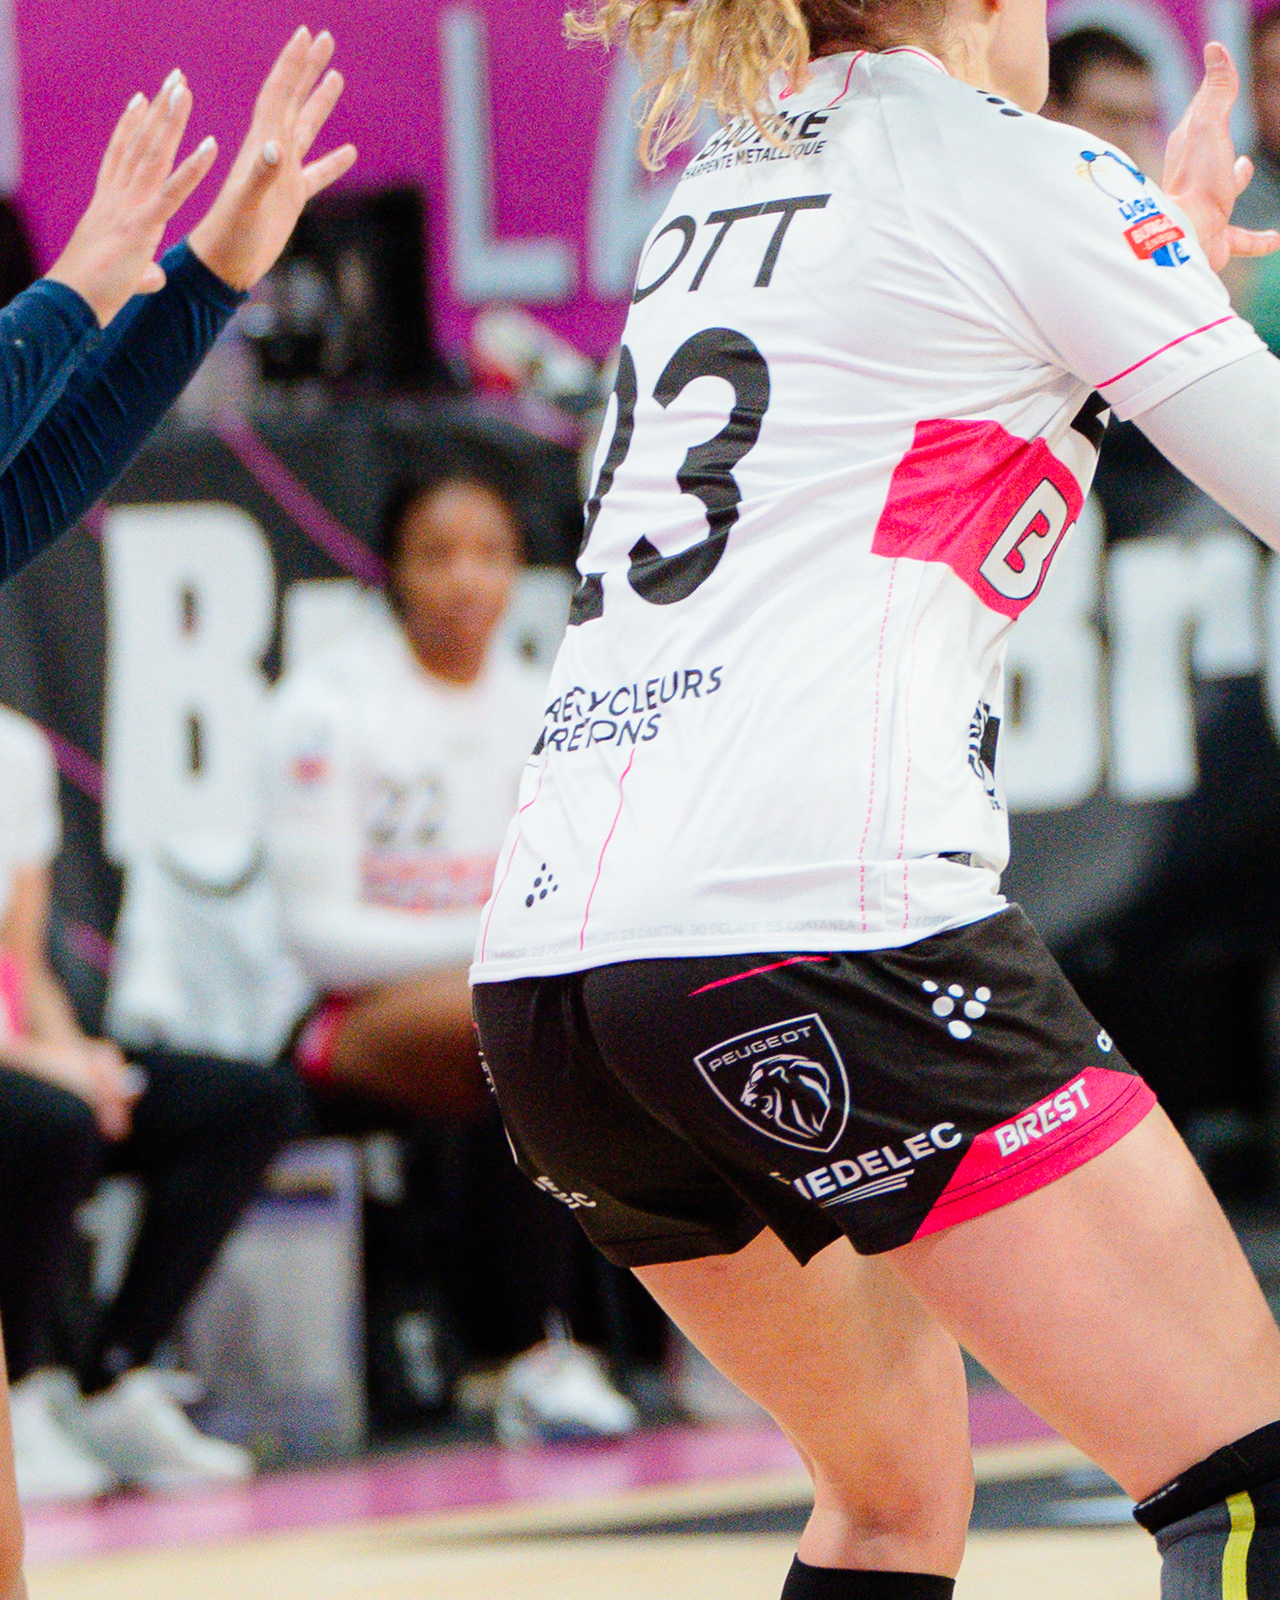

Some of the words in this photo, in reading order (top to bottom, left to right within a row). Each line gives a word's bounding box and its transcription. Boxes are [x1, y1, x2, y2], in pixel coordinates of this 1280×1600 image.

[632, 193, 832, 305] OTT
[707, 1024, 814, 1073] PEUGEOT
[994, 1078, 1092, 1158] BREST
